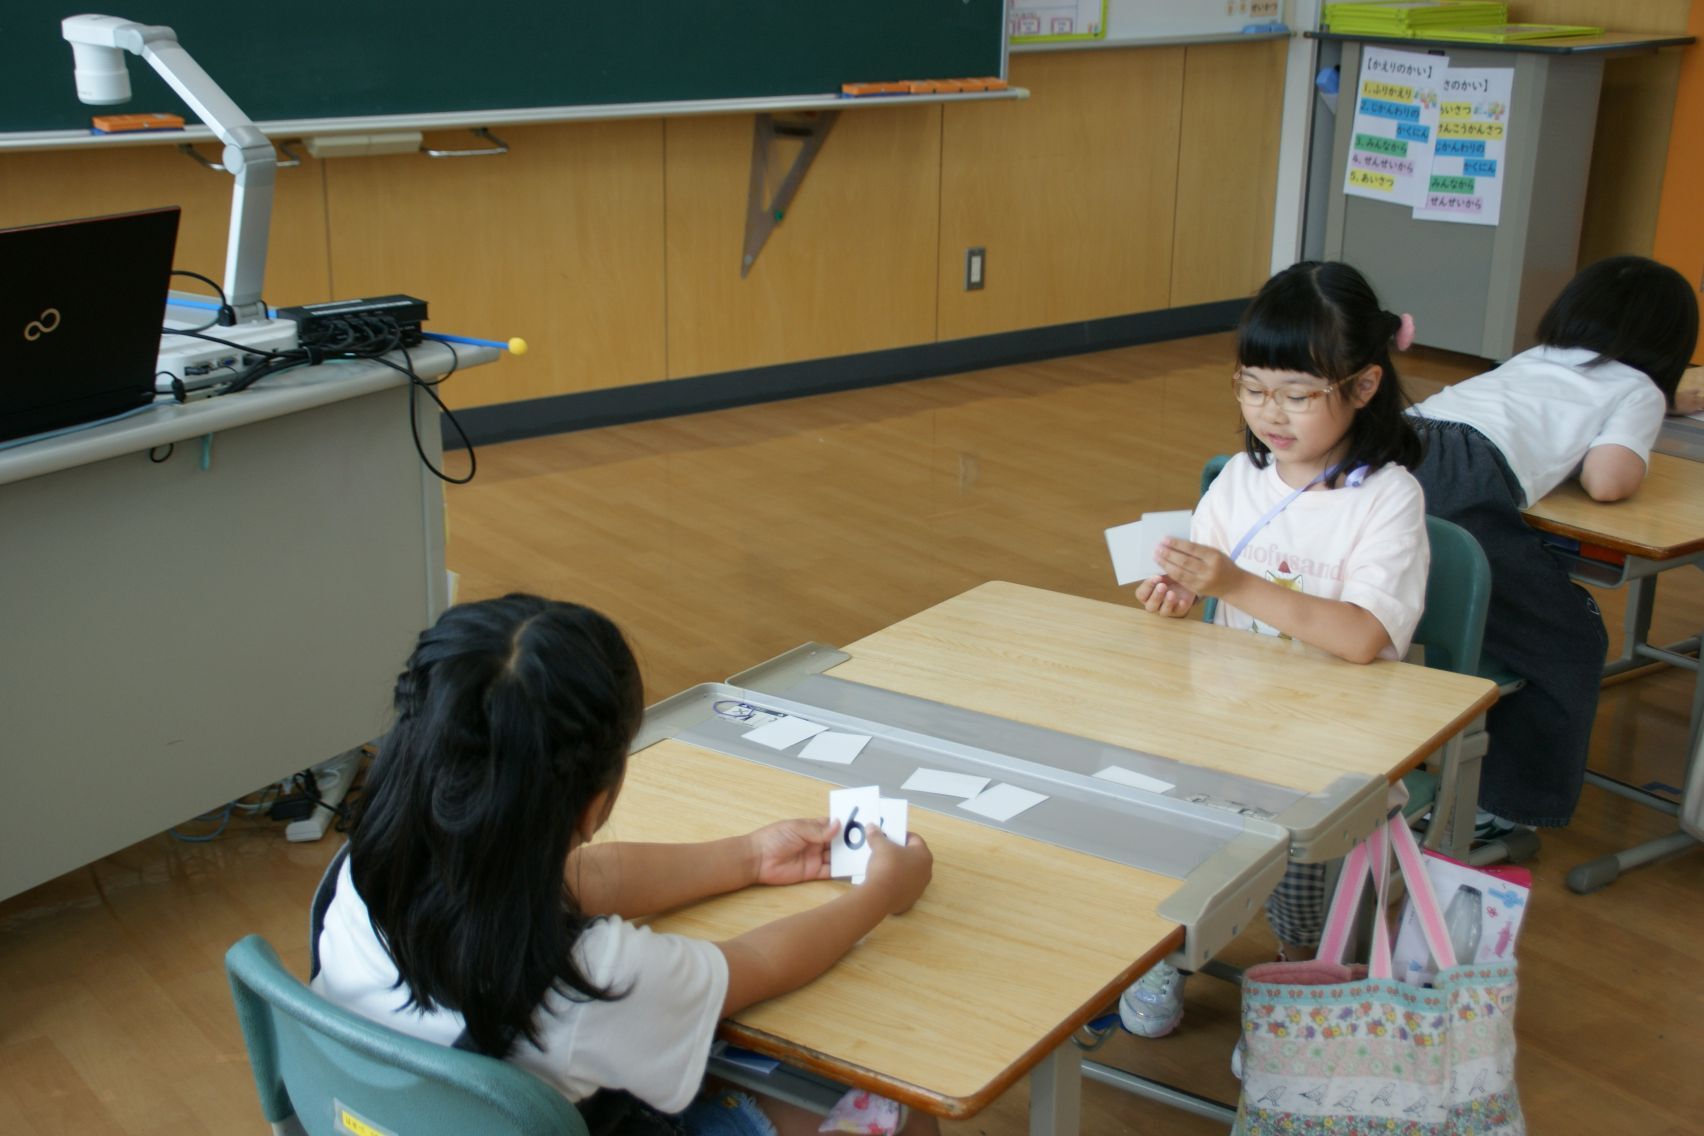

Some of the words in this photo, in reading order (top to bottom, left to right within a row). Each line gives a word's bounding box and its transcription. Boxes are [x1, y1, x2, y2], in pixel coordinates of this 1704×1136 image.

[1397, 125, 1429, 141] かくにん
[1464, 161, 1496, 173] かくにん
[844, 805, 866, 850] 6
